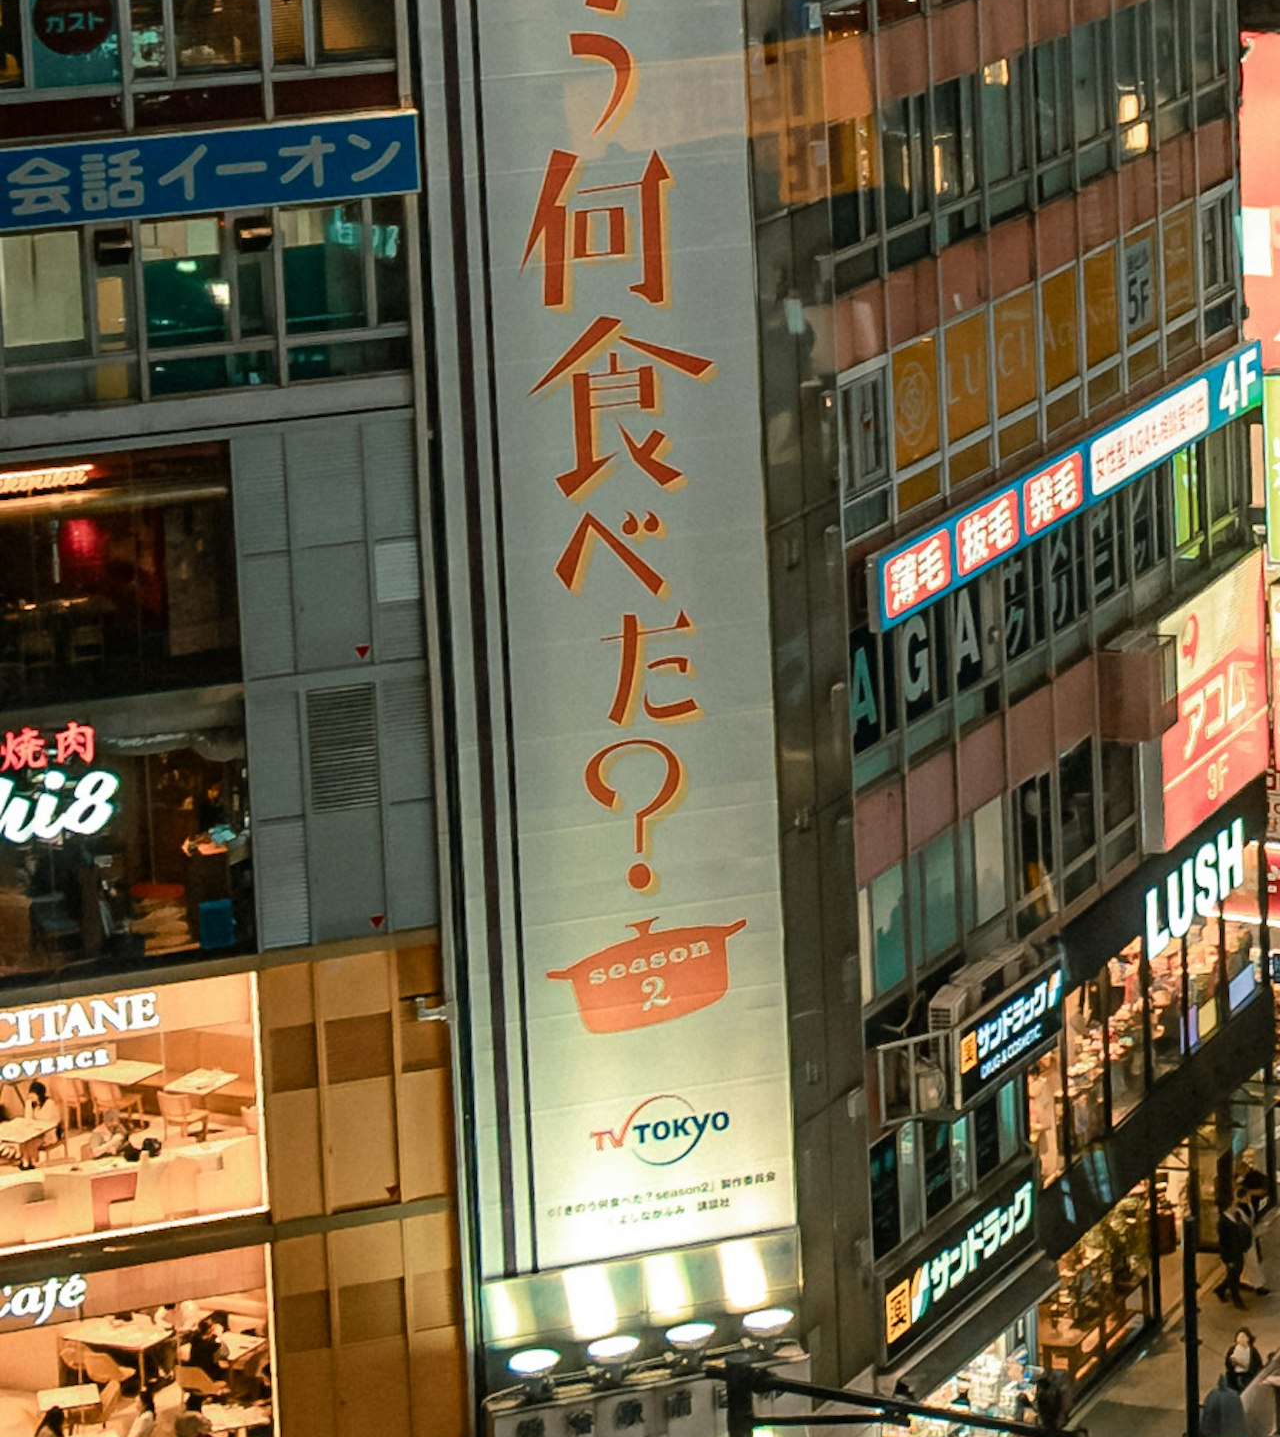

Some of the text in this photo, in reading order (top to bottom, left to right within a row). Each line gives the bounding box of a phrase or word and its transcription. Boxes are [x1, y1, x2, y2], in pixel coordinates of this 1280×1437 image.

[7, 132, 402, 216] 会話イーオン
[1126, 277, 1151, 327] 5F
[1218, 347, 1258, 416] 4F
[890, 536, 947, 611] 薄毛
[961, 496, 1015, 571] 抜毛
[1028, 460, 1080, 528] 発毛
[0, 721, 95, 772] 焼肉
[1181, 660, 1249, 762] アコム
[1146, 817, 1246, 962] LUSH
[587, 937, 711, 986] season
[641, 976, 672, 1012] 2
[977, 980, 1048, 1059] サンドラッグ
[633, 1109, 730, 1147] TOKYO
[888, 1180, 1034, 1338] 薬 サンドラッグ
